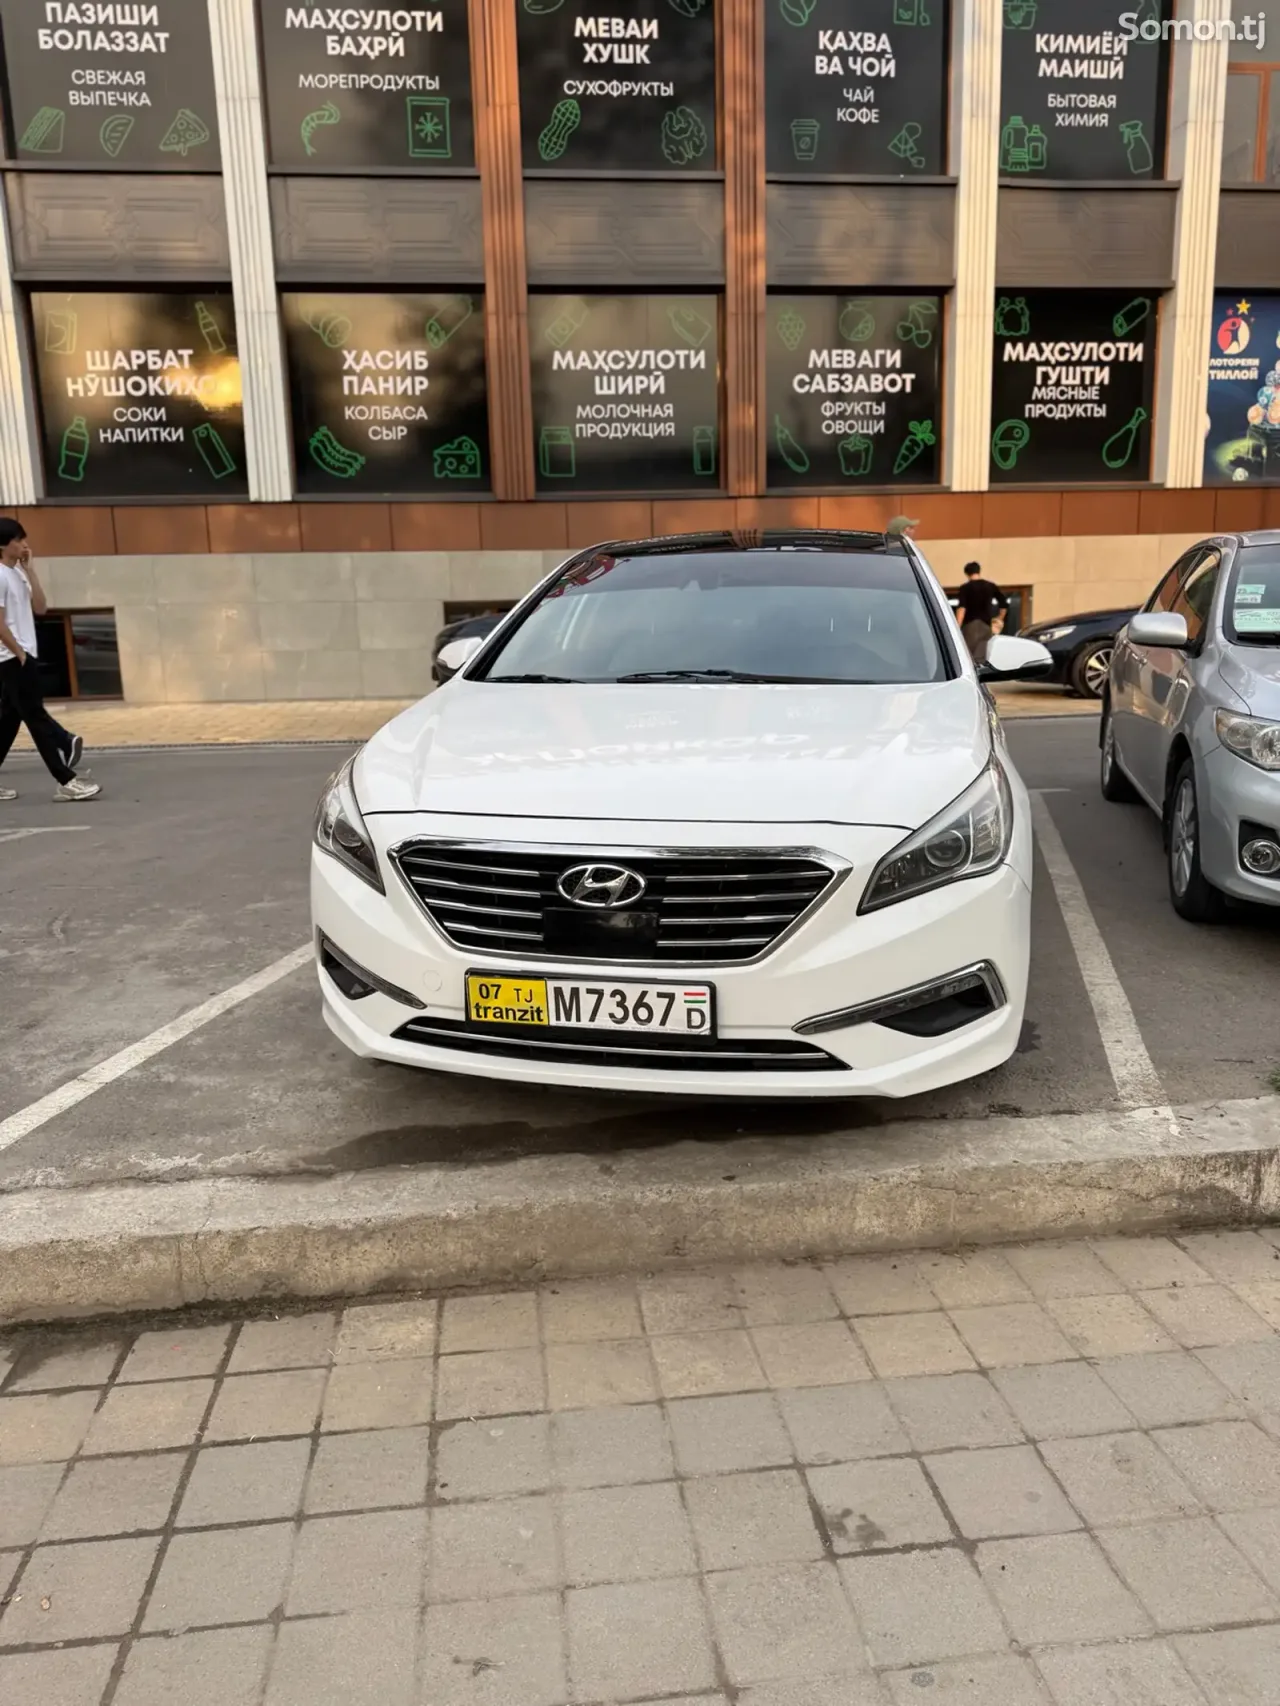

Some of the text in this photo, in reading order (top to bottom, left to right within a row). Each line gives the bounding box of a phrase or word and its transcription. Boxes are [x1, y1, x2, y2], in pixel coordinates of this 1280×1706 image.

[45, 2, 159, 26] ПАЗИШИ
[285, 8, 444, 33] МАҲСУЛОТИ
[574, 16, 659, 39] МЕВАИ
[38, 28, 170, 53] БОЛАЗЗАТ
[818, 29, 892, 54] ҚАҲВА
[583, 43, 651, 64] ХУШК
[815, 55, 844, 75] ВА
[71, 69, 146, 85] СВЕЖАЯ
[299, 74, 440, 91] МОРЕПРОДУКТЫ
[563, 80, 674, 97] СУХОФРУКТЫ
[843, 86, 875, 103] ЧАЙ
[68, 90, 152, 107] ВЫПЕЧКА
[1047, 93, 1117, 108] БЫТОВАЯ
[836, 107, 880, 124] КОФЕ
[1055, 113, 1109, 127] ХИМИЯ
[86, 349, 194, 371] ШАРБАТ
[342, 349, 429, 373] ҲАСИБ
[552, 350, 706, 373] МАҲСУЛОТИ
[808, 349, 901, 369] МЕВАГИ
[1003, 342, 1144, 364] МАҲСУЛОТИ
[792, 373, 916, 393] САБЗАВОТ
[1036, 366, 1110, 385] ГУШТИ
[343, 375, 429, 396] ПАНИР
[1031, 386, 1100, 400] МЯСНЫЕ
[113, 407, 167, 422] СОКИ
[344, 405, 428, 420] КОЛБАСА
[576, 403, 674, 419] МОЛОЧНАЯ
[821, 400, 886, 417] ФРУКТЫ
[1024, 404, 1107, 419] ПРОДУКТЫ
[99, 427, 185, 443] НАПИТКИ
[368, 425, 408, 441] СЫР
[575, 422, 675, 440] ПРОДУКЦИЯ
[822, 420, 885, 435] ОВОЩИ
[478, 983, 533, 1003] 07 TJ
[474, 1002, 544, 1022] tranzit
[553, 986, 676, 1027] M7367
[687, 1008, 706, 1030] D
